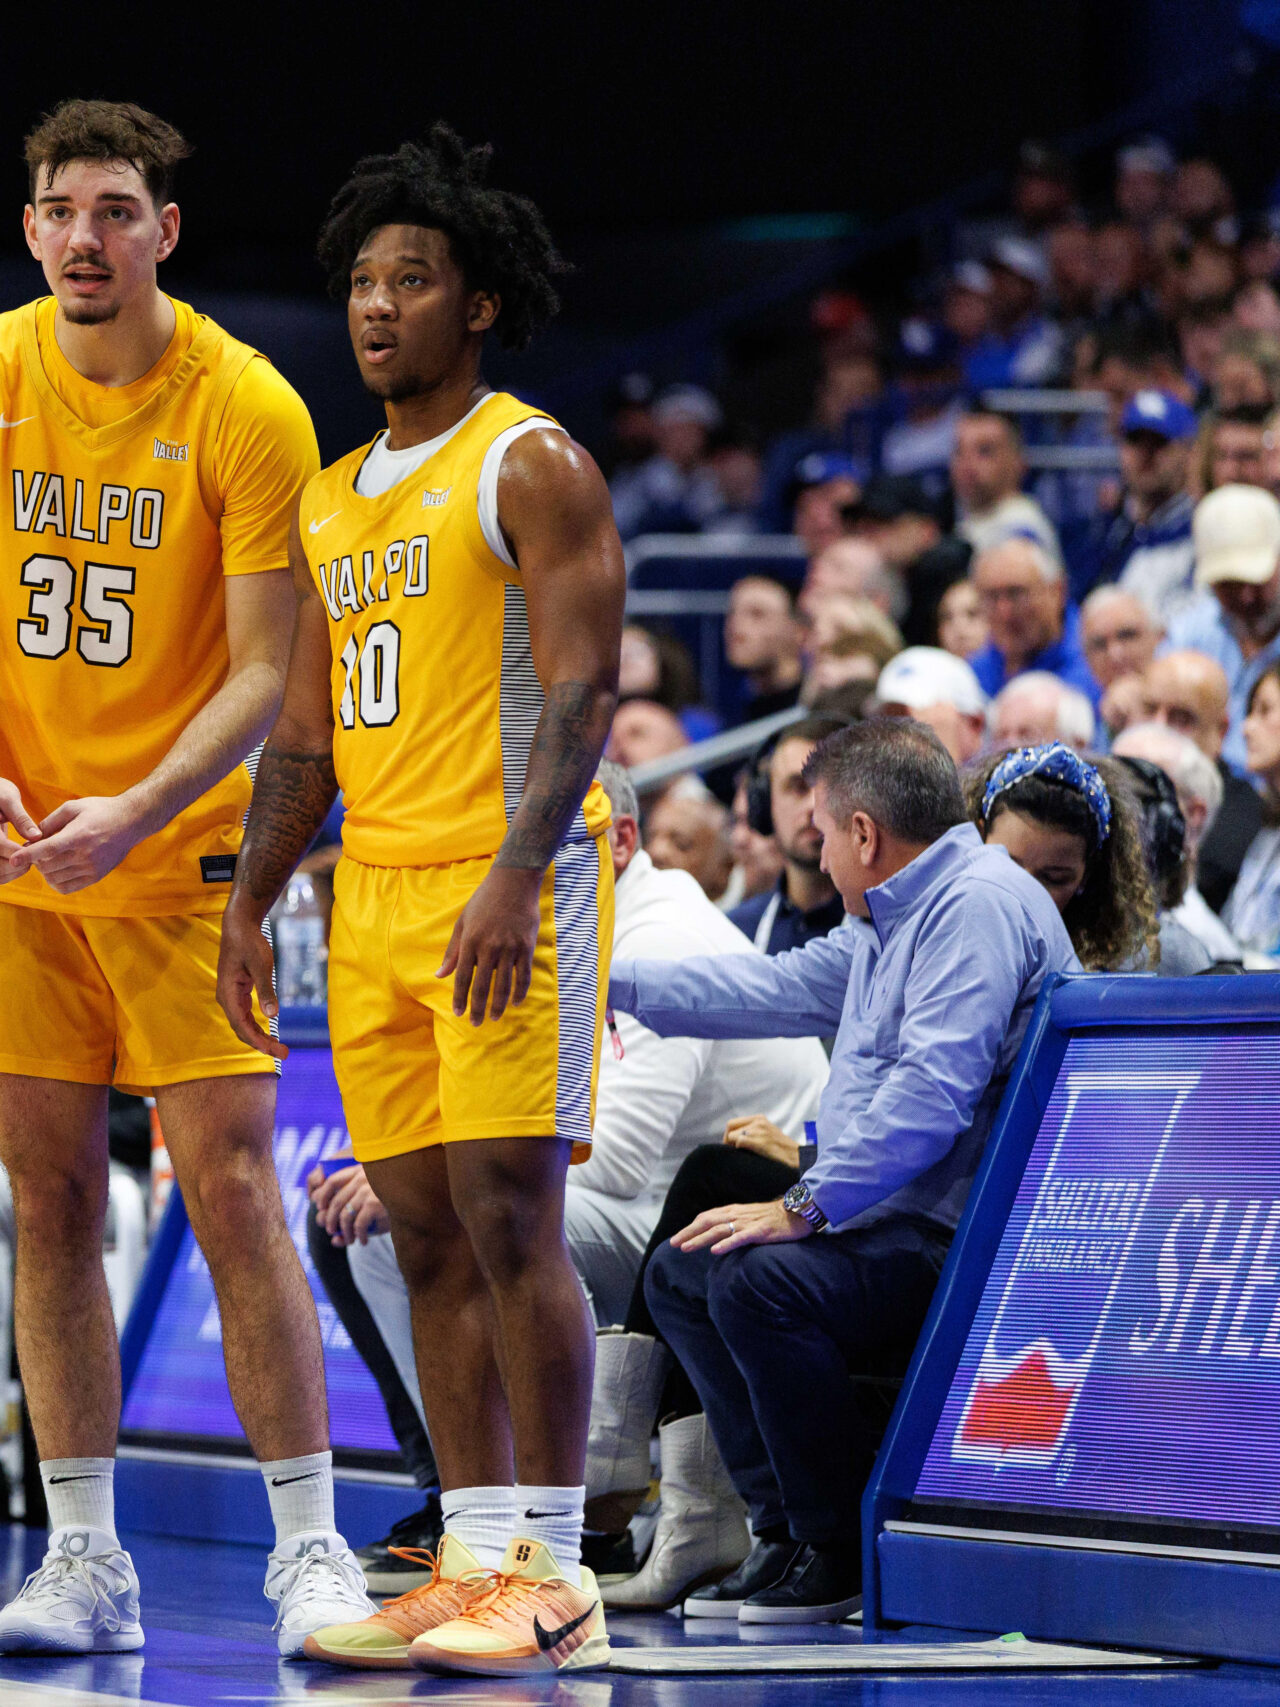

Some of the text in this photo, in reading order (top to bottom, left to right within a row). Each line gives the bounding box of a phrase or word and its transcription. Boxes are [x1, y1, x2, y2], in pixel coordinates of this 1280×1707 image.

[153, 437, 190, 461] VALLEY
[12, 469, 165, 550] VALPO
[16, 552, 137, 669] 35
[319, 534, 430, 622] VALPO
[339, 618, 402, 731] 10
